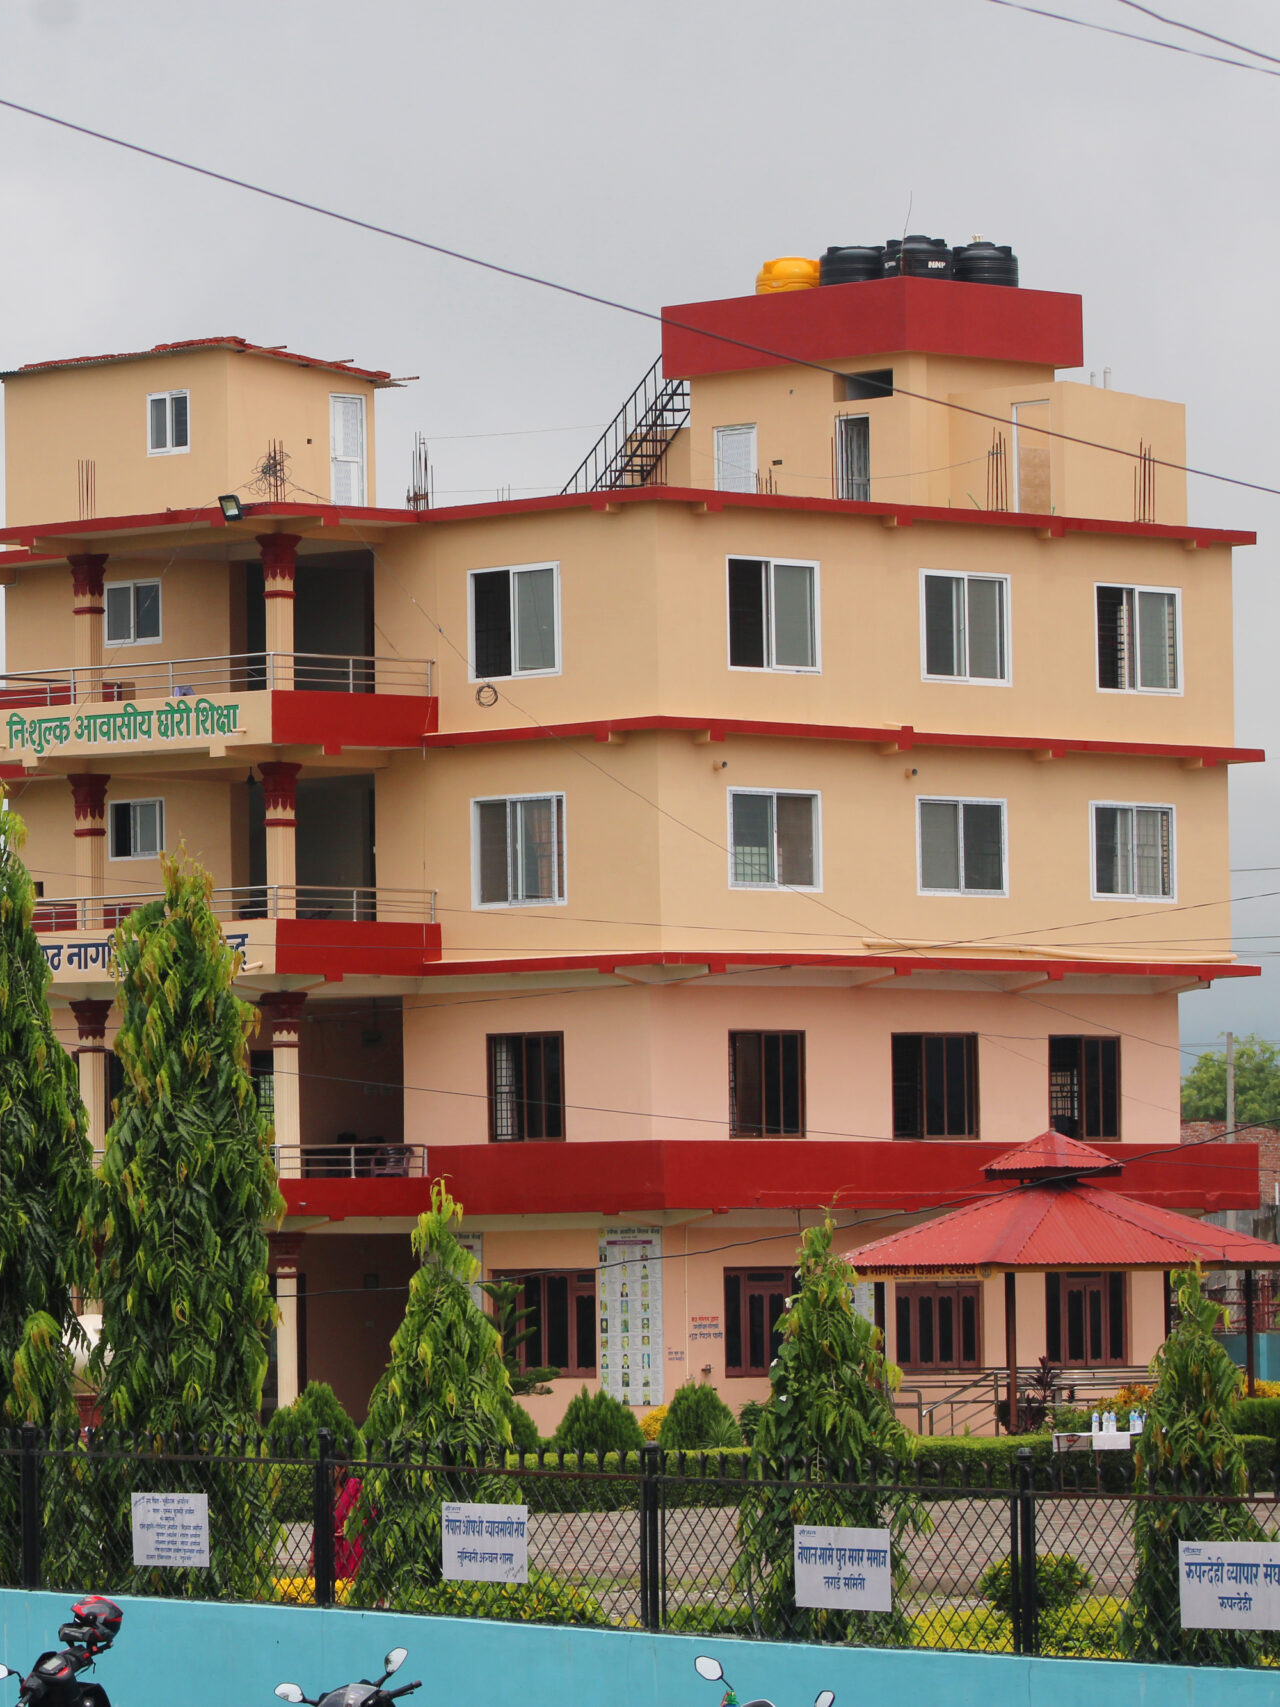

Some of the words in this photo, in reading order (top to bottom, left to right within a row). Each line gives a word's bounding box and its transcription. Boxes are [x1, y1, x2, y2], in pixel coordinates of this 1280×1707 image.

[74, 703, 154, 743] आवासीय
[156, 700, 193, 739] छोरी
[194, 698, 240, 736] शिक्षा
[445, 1515, 462, 1536] नेपाल
[514, 1516, 526, 1538] संघ
[798, 1541, 819, 1565] नेपाल
[835, 1547, 847, 1571] पुन
[847, 1548, 866, 1567] मगर
[865, 1549, 888, 1568] समाज
[1184, 1556, 1225, 1586] रुपन्देही
[1226, 1562, 1261, 1586] व्यापार
[1218, 1591, 1253, 1612] रुपन्देही
